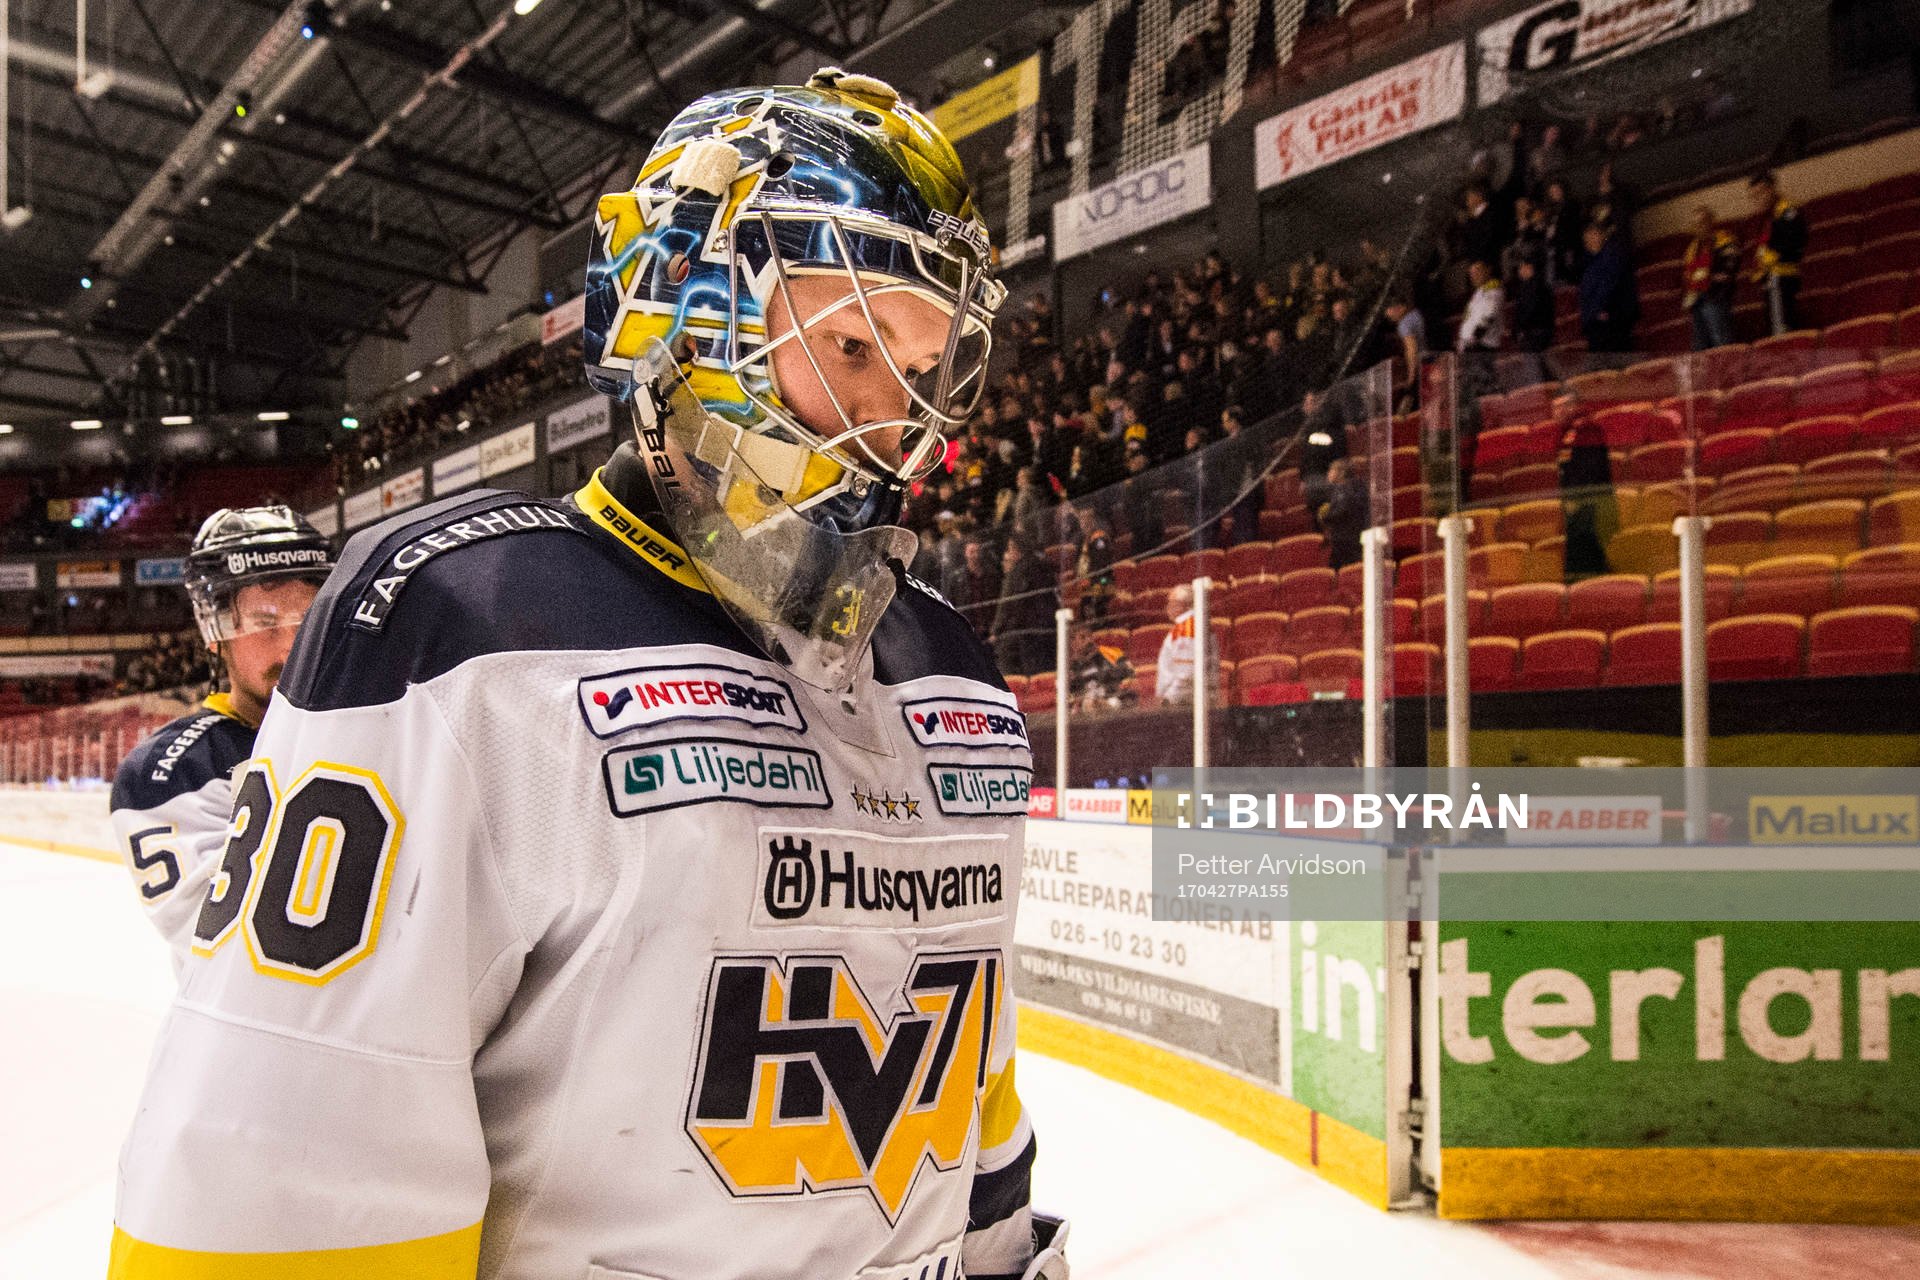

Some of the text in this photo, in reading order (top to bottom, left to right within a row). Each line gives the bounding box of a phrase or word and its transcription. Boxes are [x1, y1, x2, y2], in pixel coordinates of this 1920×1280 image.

[1378, 97, 1419, 128] AB
[600, 504, 685, 570] BAUER
[246, 550, 326, 567] Husqvarna
[635, 681, 786, 716] INTERSPORT
[670, 746, 820, 792] Liljedahl
[960, 771, 1030, 810] Liljeda
[1068, 799, 1122, 813] GRABBER
[1128, 797, 1189, 821] Malux
[1754, 803, 1912, 836] Malux
[130, 824, 184, 900] 5
[192, 757, 406, 987] 30
[820, 849, 1003, 922] Husqvarna
[1239, 908, 1274, 941] AB
[1130, 934, 1153, 959] 23
[1161, 941, 1187, 967] 30
[690, 955, 1000, 1200] HV71
